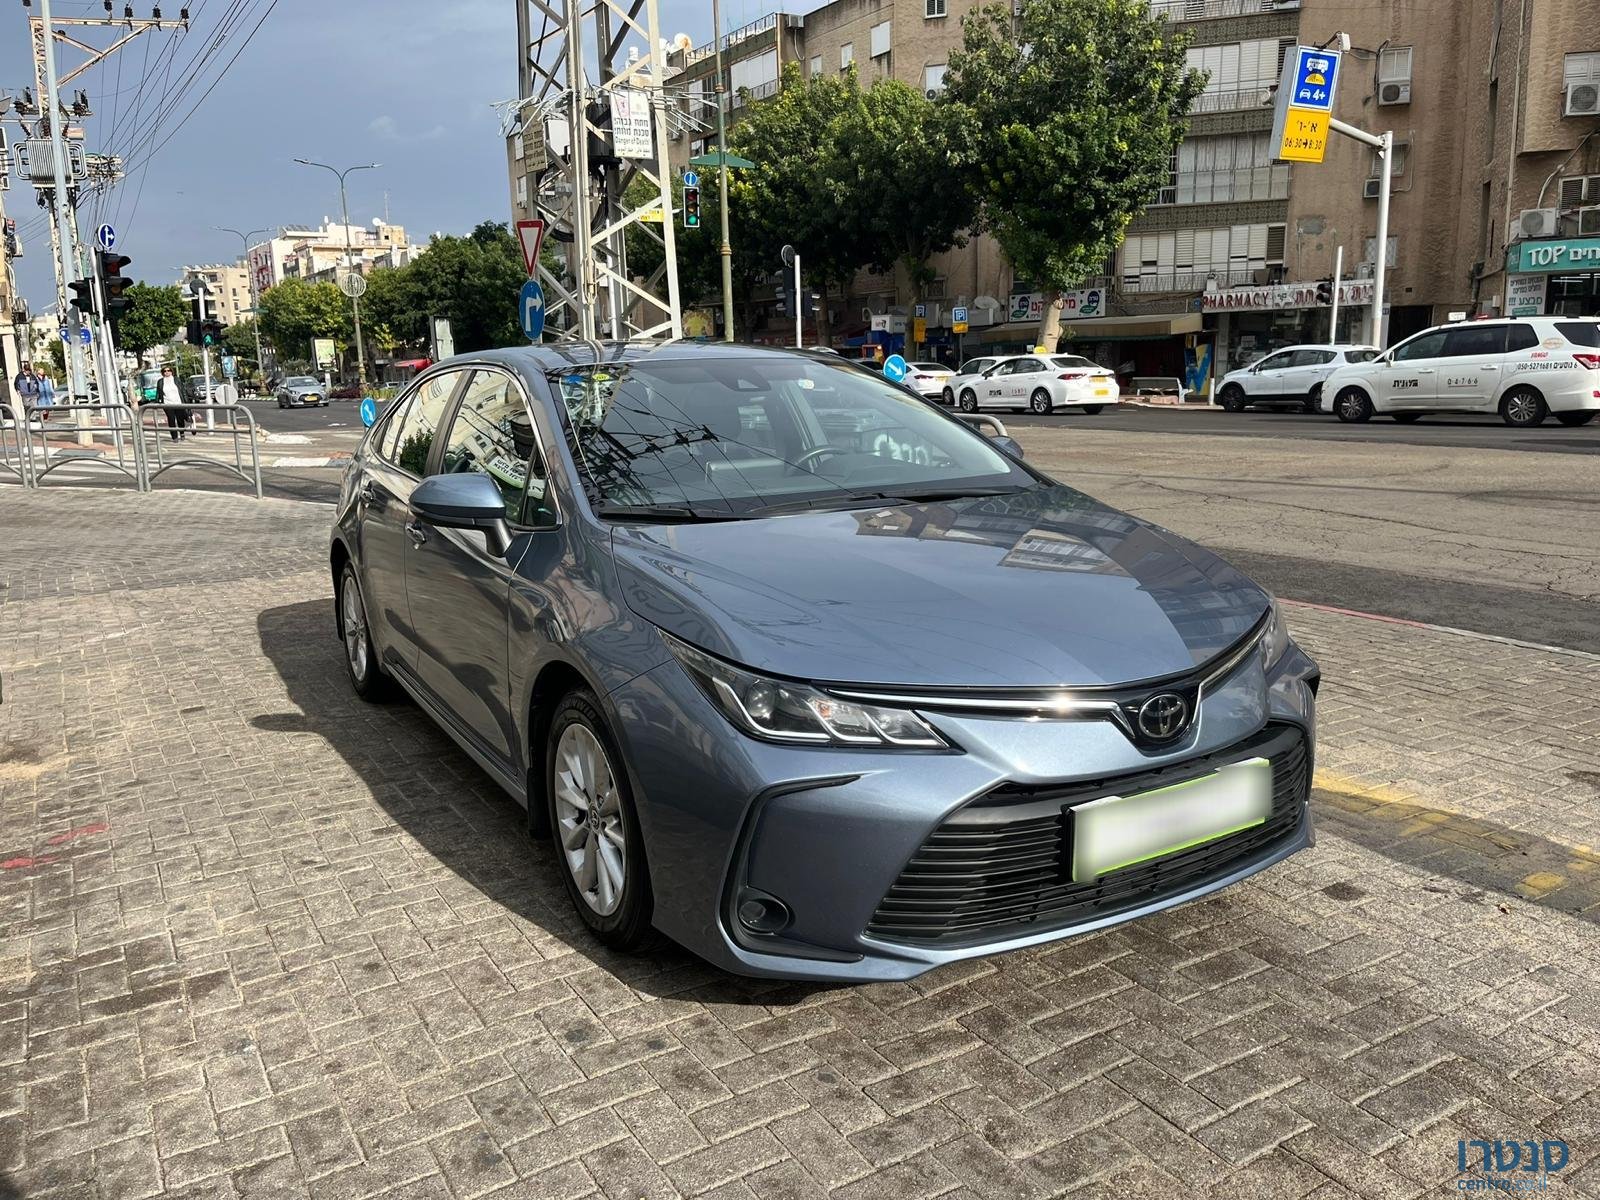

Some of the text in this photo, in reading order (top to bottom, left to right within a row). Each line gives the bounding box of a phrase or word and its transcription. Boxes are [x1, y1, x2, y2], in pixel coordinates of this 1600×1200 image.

[1312, 89, 1325, 100] 4+
[633, 128, 649, 137] סכנת
[1528, 245, 1567, 266] TOP
[1202, 291, 1269, 309] PHARMACY
